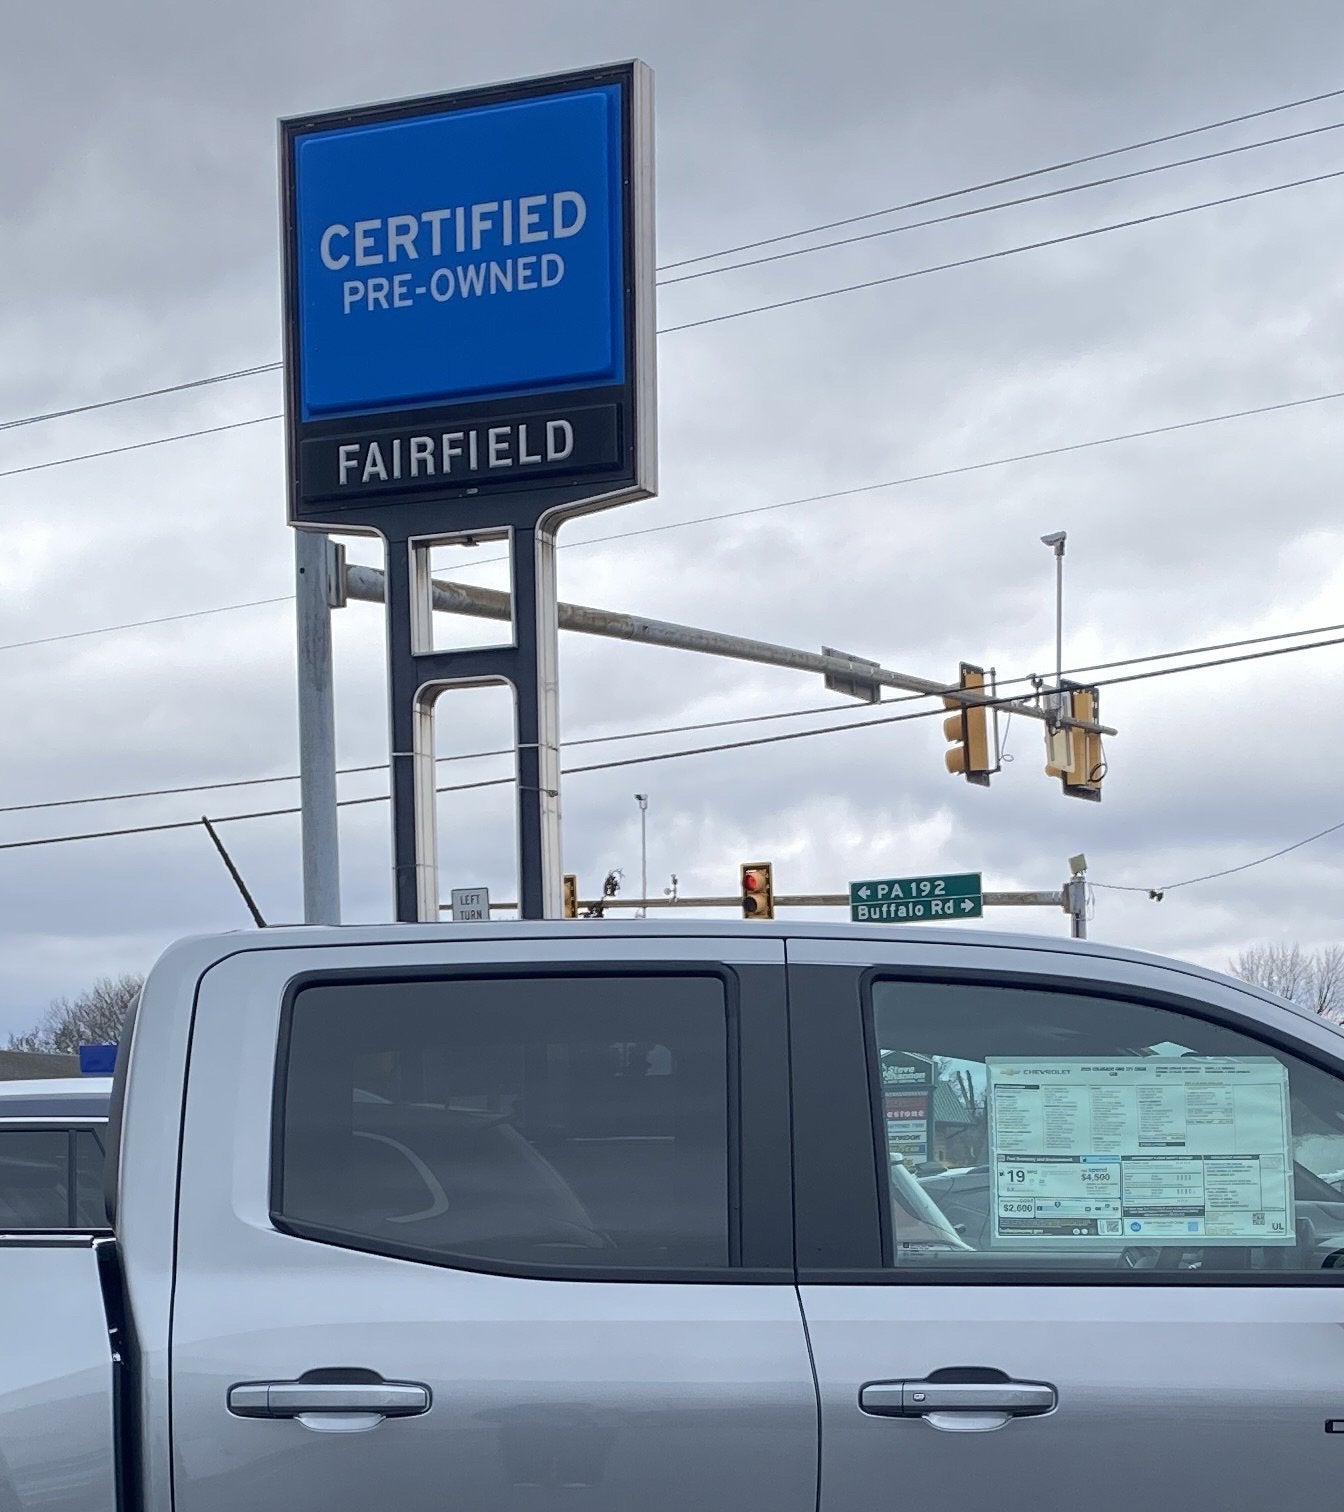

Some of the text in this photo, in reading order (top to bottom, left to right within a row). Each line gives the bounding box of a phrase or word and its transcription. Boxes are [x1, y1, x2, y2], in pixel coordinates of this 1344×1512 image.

[319, 190, 587, 270] CERTIFIED
[343, 253, 565, 314] PRE-OWNED
[338, 419, 574, 485] FAIRFIELD
[877, 880, 946, 899] PA 192
[460, 894, 481, 906] LEFT
[460, 909, 483, 921] TURN
[858, 900, 954, 920] Buffalo Rd
[1007, 1169, 1025, 1183] 19
